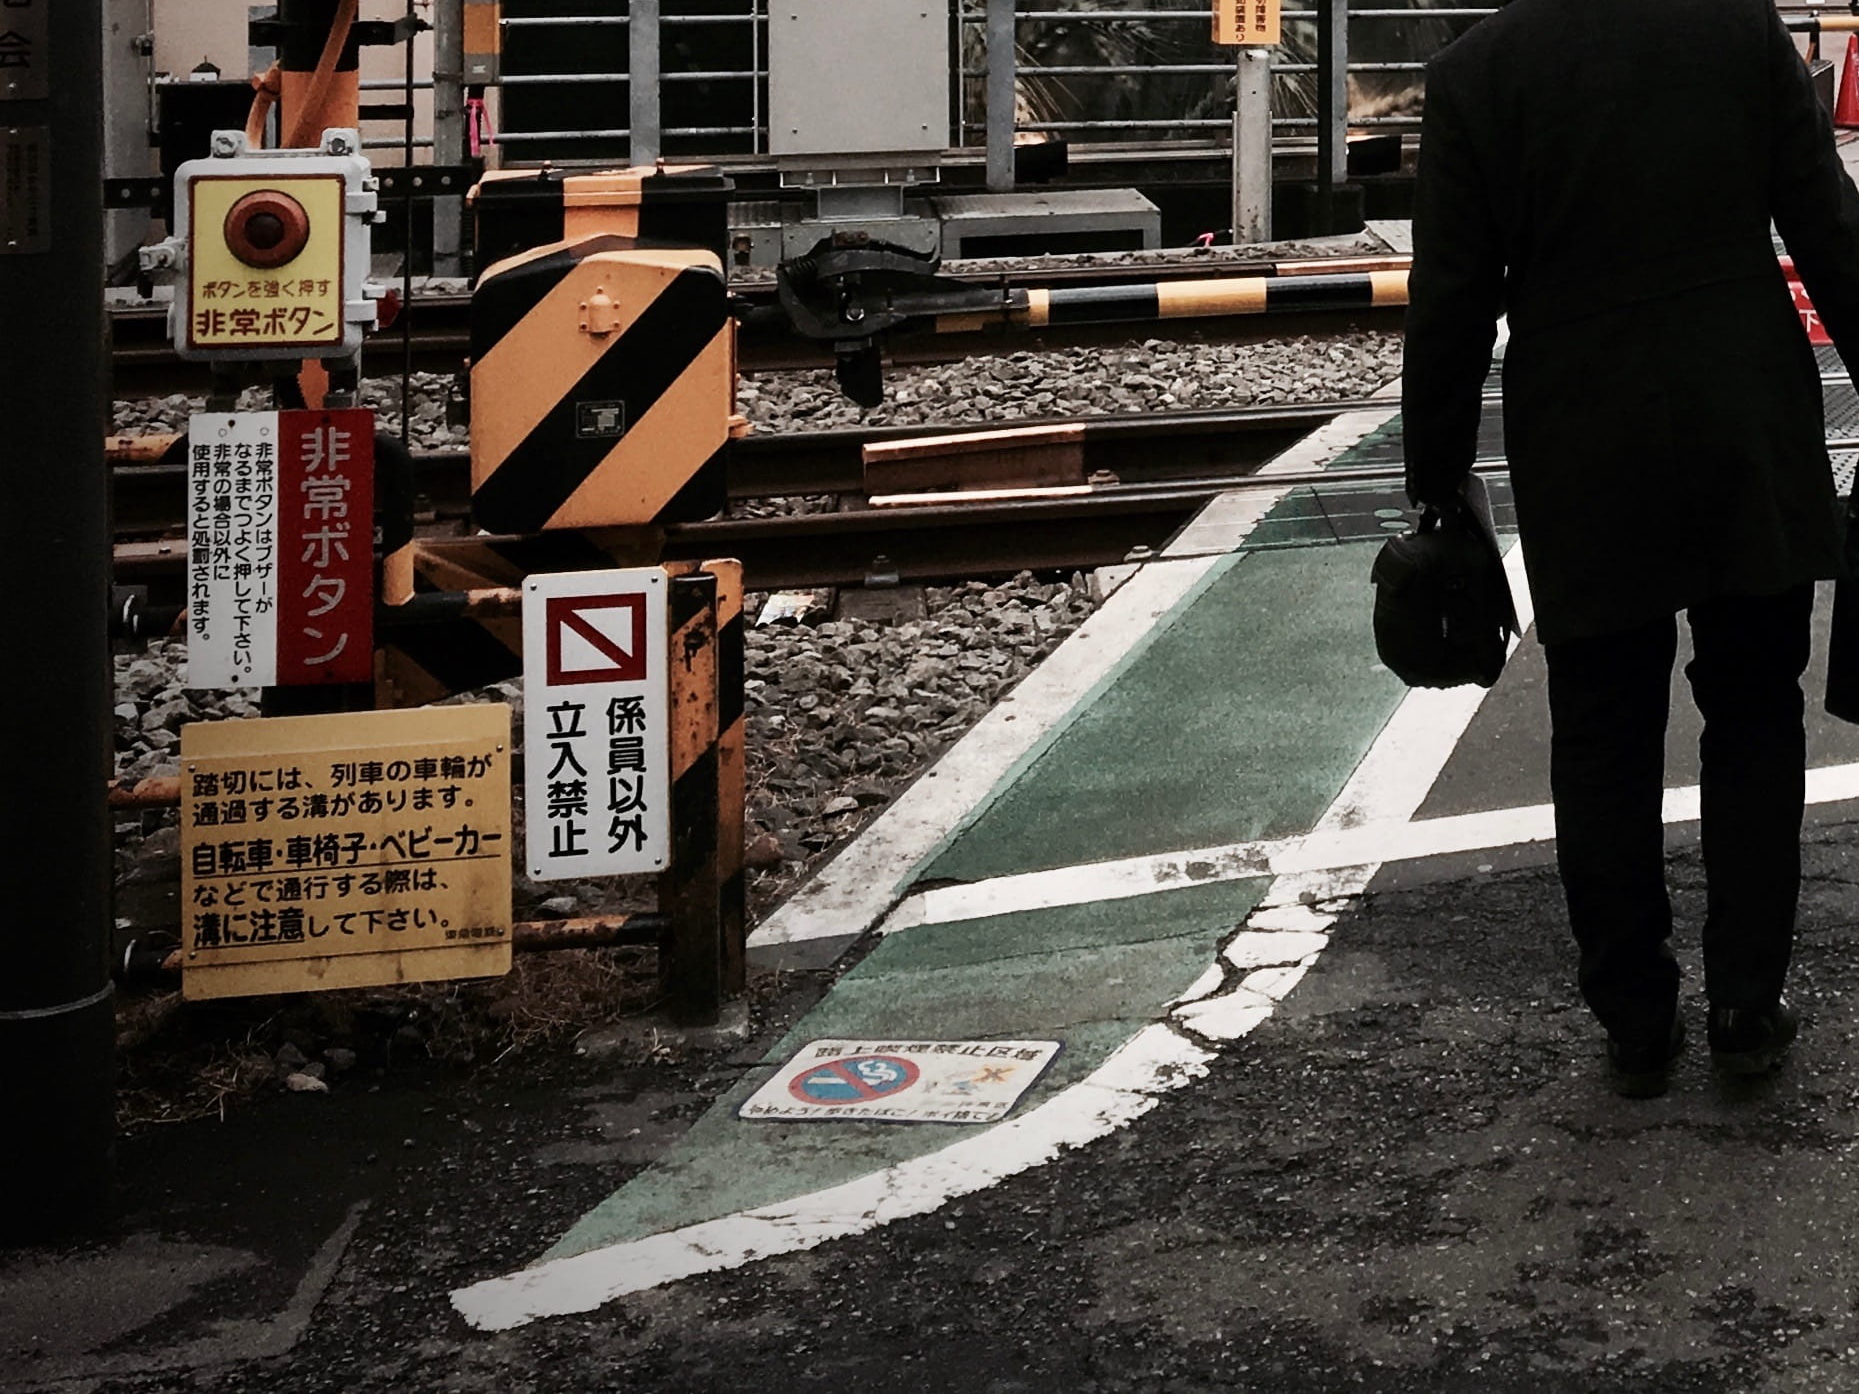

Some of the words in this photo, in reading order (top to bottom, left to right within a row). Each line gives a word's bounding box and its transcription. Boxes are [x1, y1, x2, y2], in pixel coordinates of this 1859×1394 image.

[202, 279, 332, 299] ボタンを強く押す
[195, 307, 335, 337] 非常ボタン
[213, 444, 232, 581] 非常の場合以外に
[191, 444, 211, 641] 使用すると処罰されます。
[233, 443, 252, 674] なるまでつよく押して下さい。
[301, 427, 351, 665] 非常ボタン
[192, 755, 492, 798] 踏切には、列車の車輪が
[546, 701, 589, 858] 立入禁止
[606, 695, 648, 854] 係員以外
[192, 784, 475, 828] 通過する溝があります。
[192, 824, 502, 876] 自転車・車椅子・ベビーカー
[193, 867, 450, 907] などで通行する際は、
[193, 907, 450, 947] 溝に注意して下さい。
